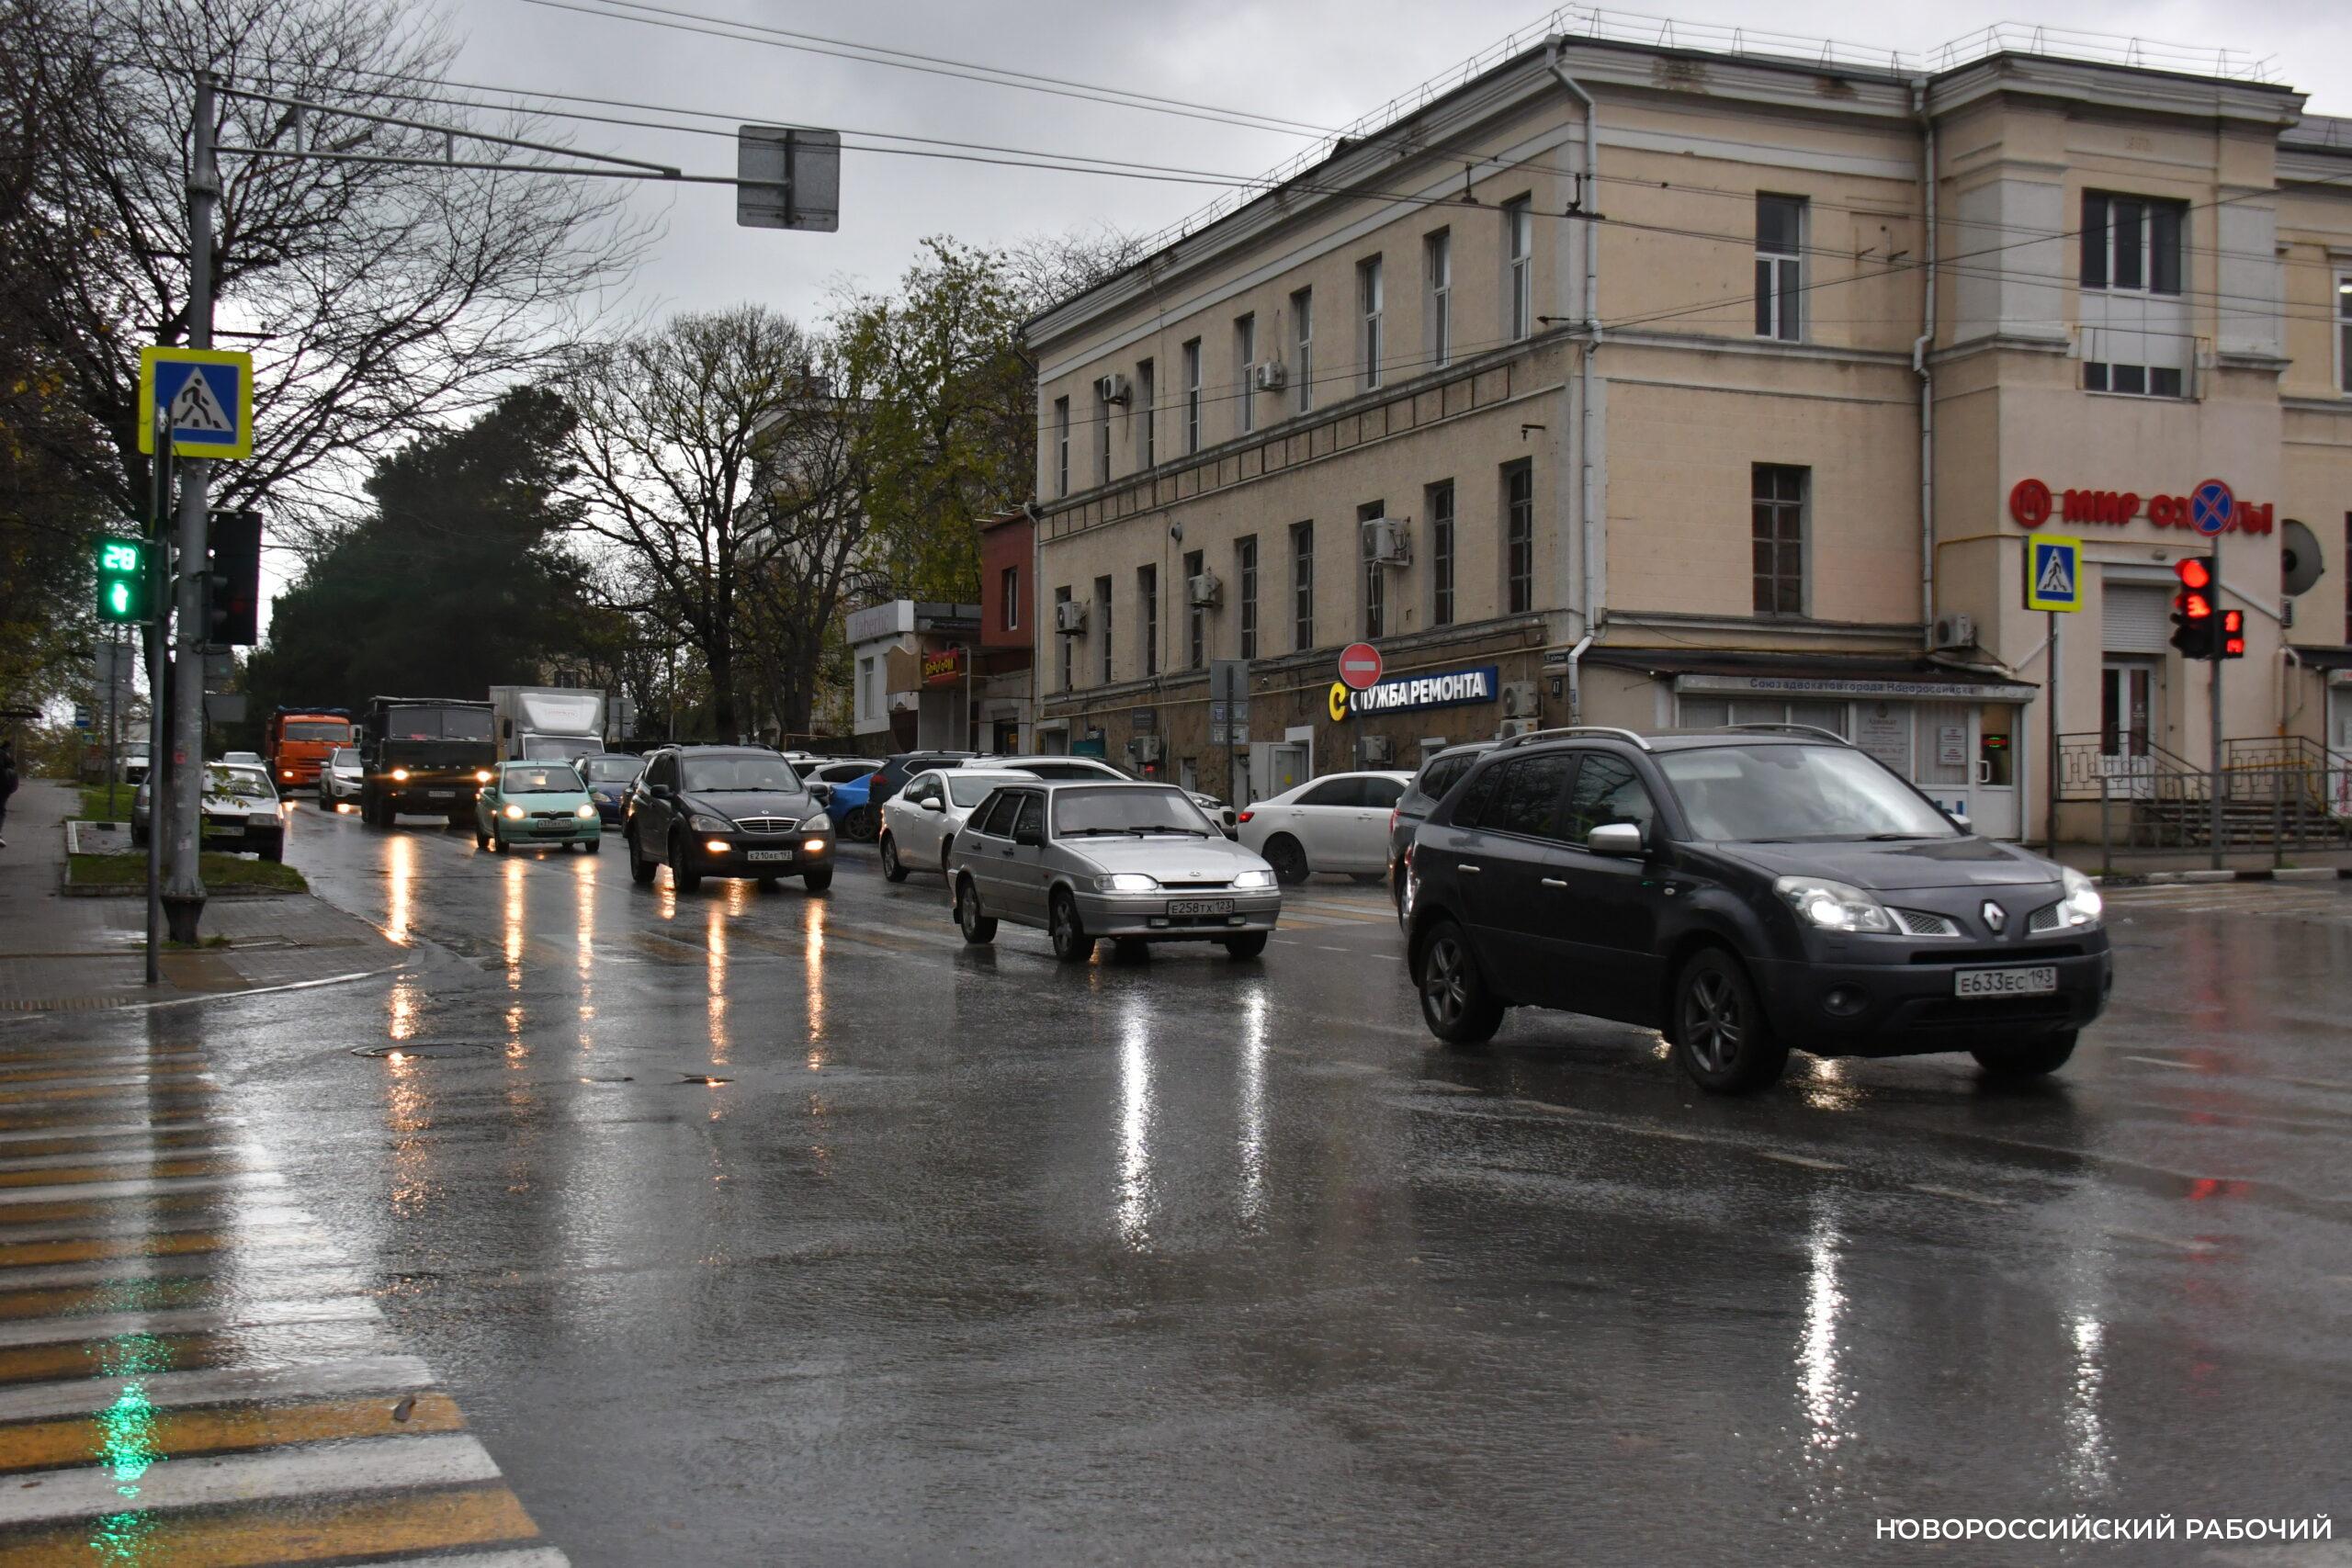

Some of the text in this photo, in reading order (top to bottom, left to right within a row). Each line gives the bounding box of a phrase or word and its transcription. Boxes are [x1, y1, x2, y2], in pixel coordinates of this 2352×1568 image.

[2062, 489, 2140, 525] МИР
[103, 545, 136, 570] 28
[1410, 671, 1487, 704] РЕМОНТА
[1749, 678, 1781, 689] Союз
[1171, 901, 1230, 913] Е258ТХ 123
[1961, 969, 2052, 992] Е633ЕС 193
